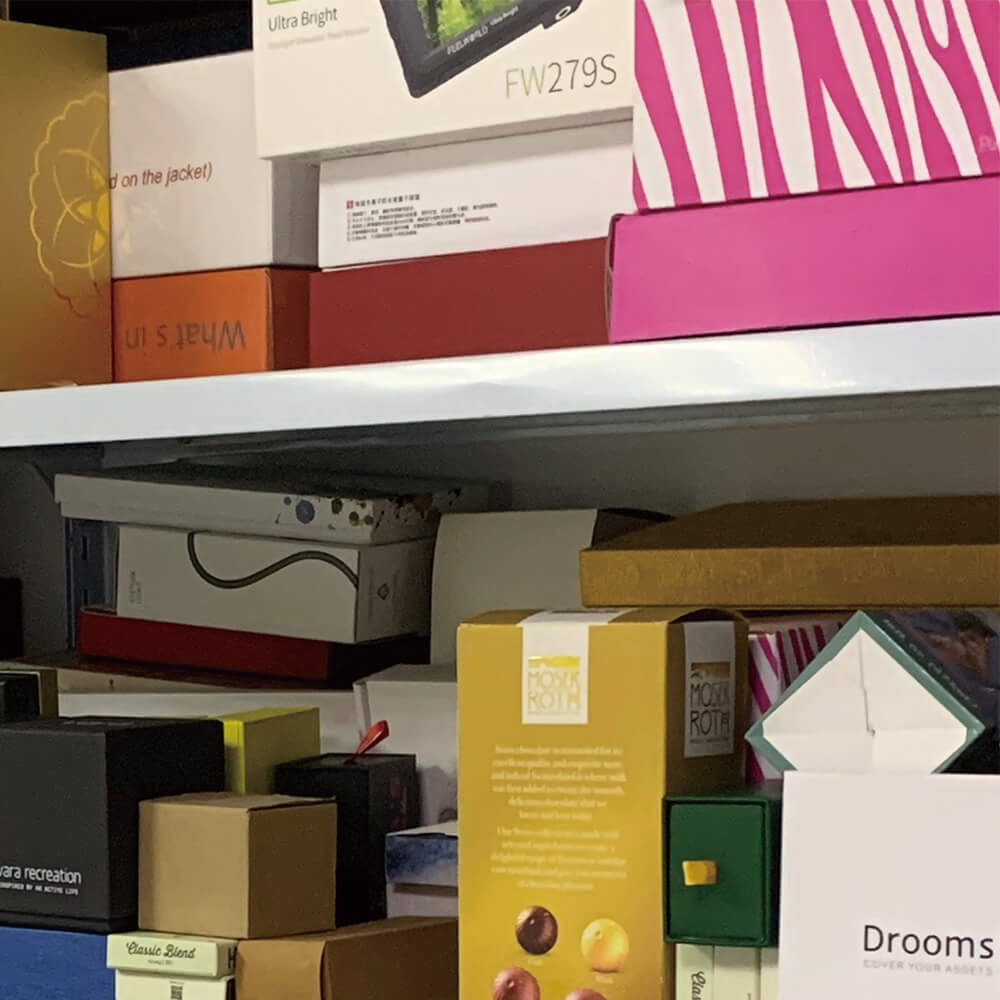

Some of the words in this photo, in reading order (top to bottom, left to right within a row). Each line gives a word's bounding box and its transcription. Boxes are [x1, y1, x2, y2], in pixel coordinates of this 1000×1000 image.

[268, 15, 298, 32] Ultra
[301, 8, 338, 28] Bright
[505, 53, 617, 99] FW279S
[121, 174, 138, 188] on
[142, 168, 163, 186] the
[165, 162, 213, 187] jacket)
[690, 710, 730, 737] ROTH
[24, 867, 82, 885] recreation
[126, 942, 162, 957] Classic
[163, 943, 197, 959] Blend
[863, 924, 994, 959] Drooms
[863, 959, 904, 969] COVER
[908, 962, 941, 973] YOUR
[945, 964, 994, 977] ASSETS
